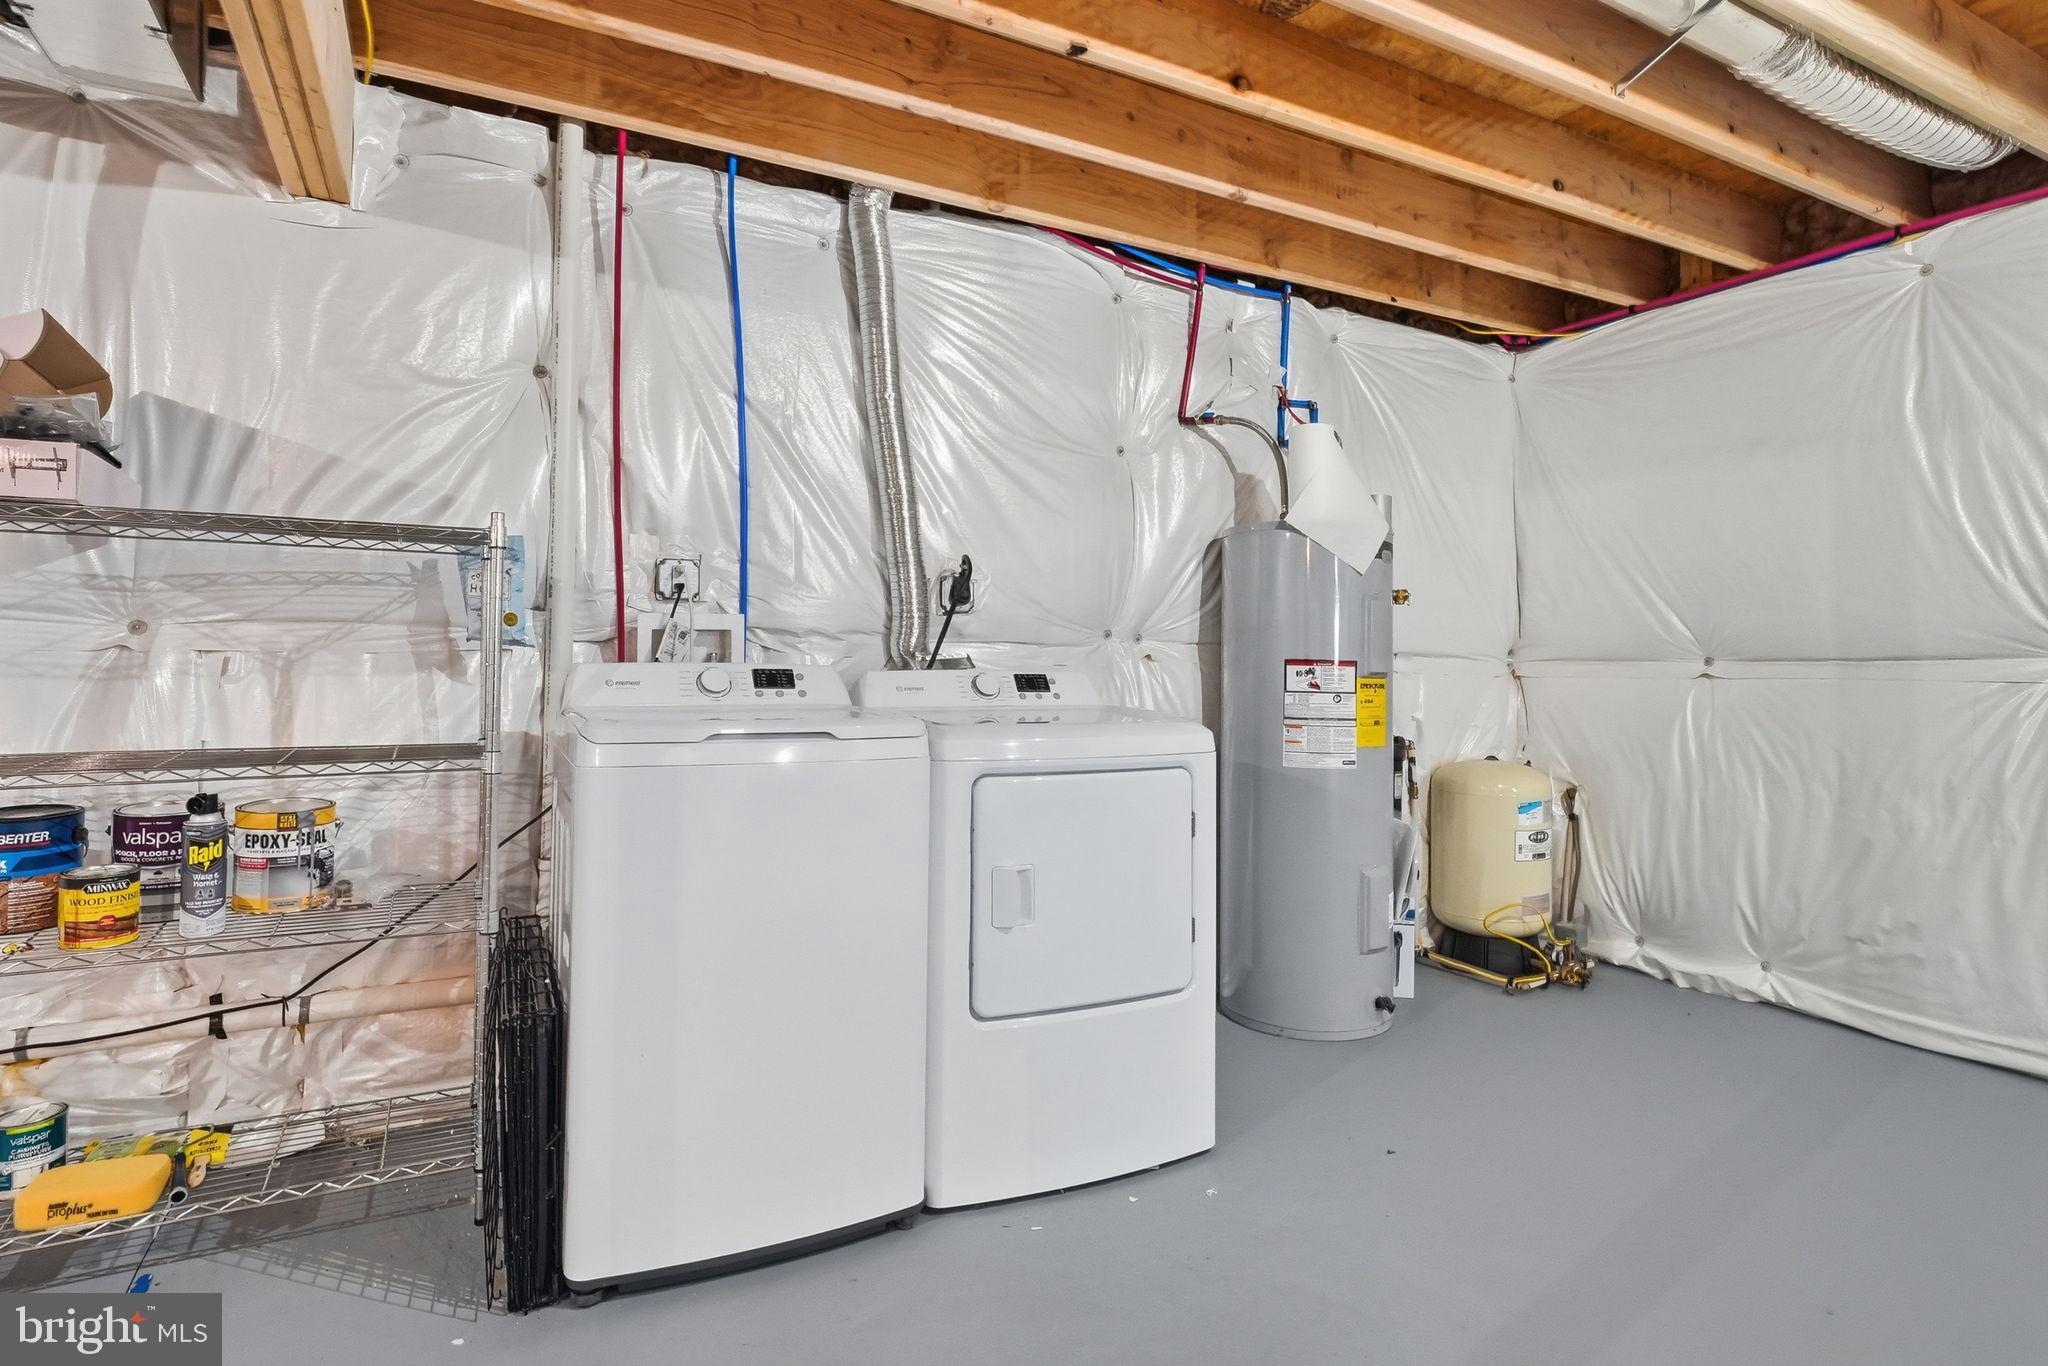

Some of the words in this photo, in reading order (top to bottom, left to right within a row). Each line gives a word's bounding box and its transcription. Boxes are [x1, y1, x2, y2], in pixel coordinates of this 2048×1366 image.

[122, 827, 182, 849] valspa
[244, 829, 327, 849] EPOXY-SEAL
[188, 839, 223, 865] Raid
[87, 881, 128, 894] MINWAX
[69, 897, 106, 907] WOOD
[10, 1130, 51, 1146] valspar
